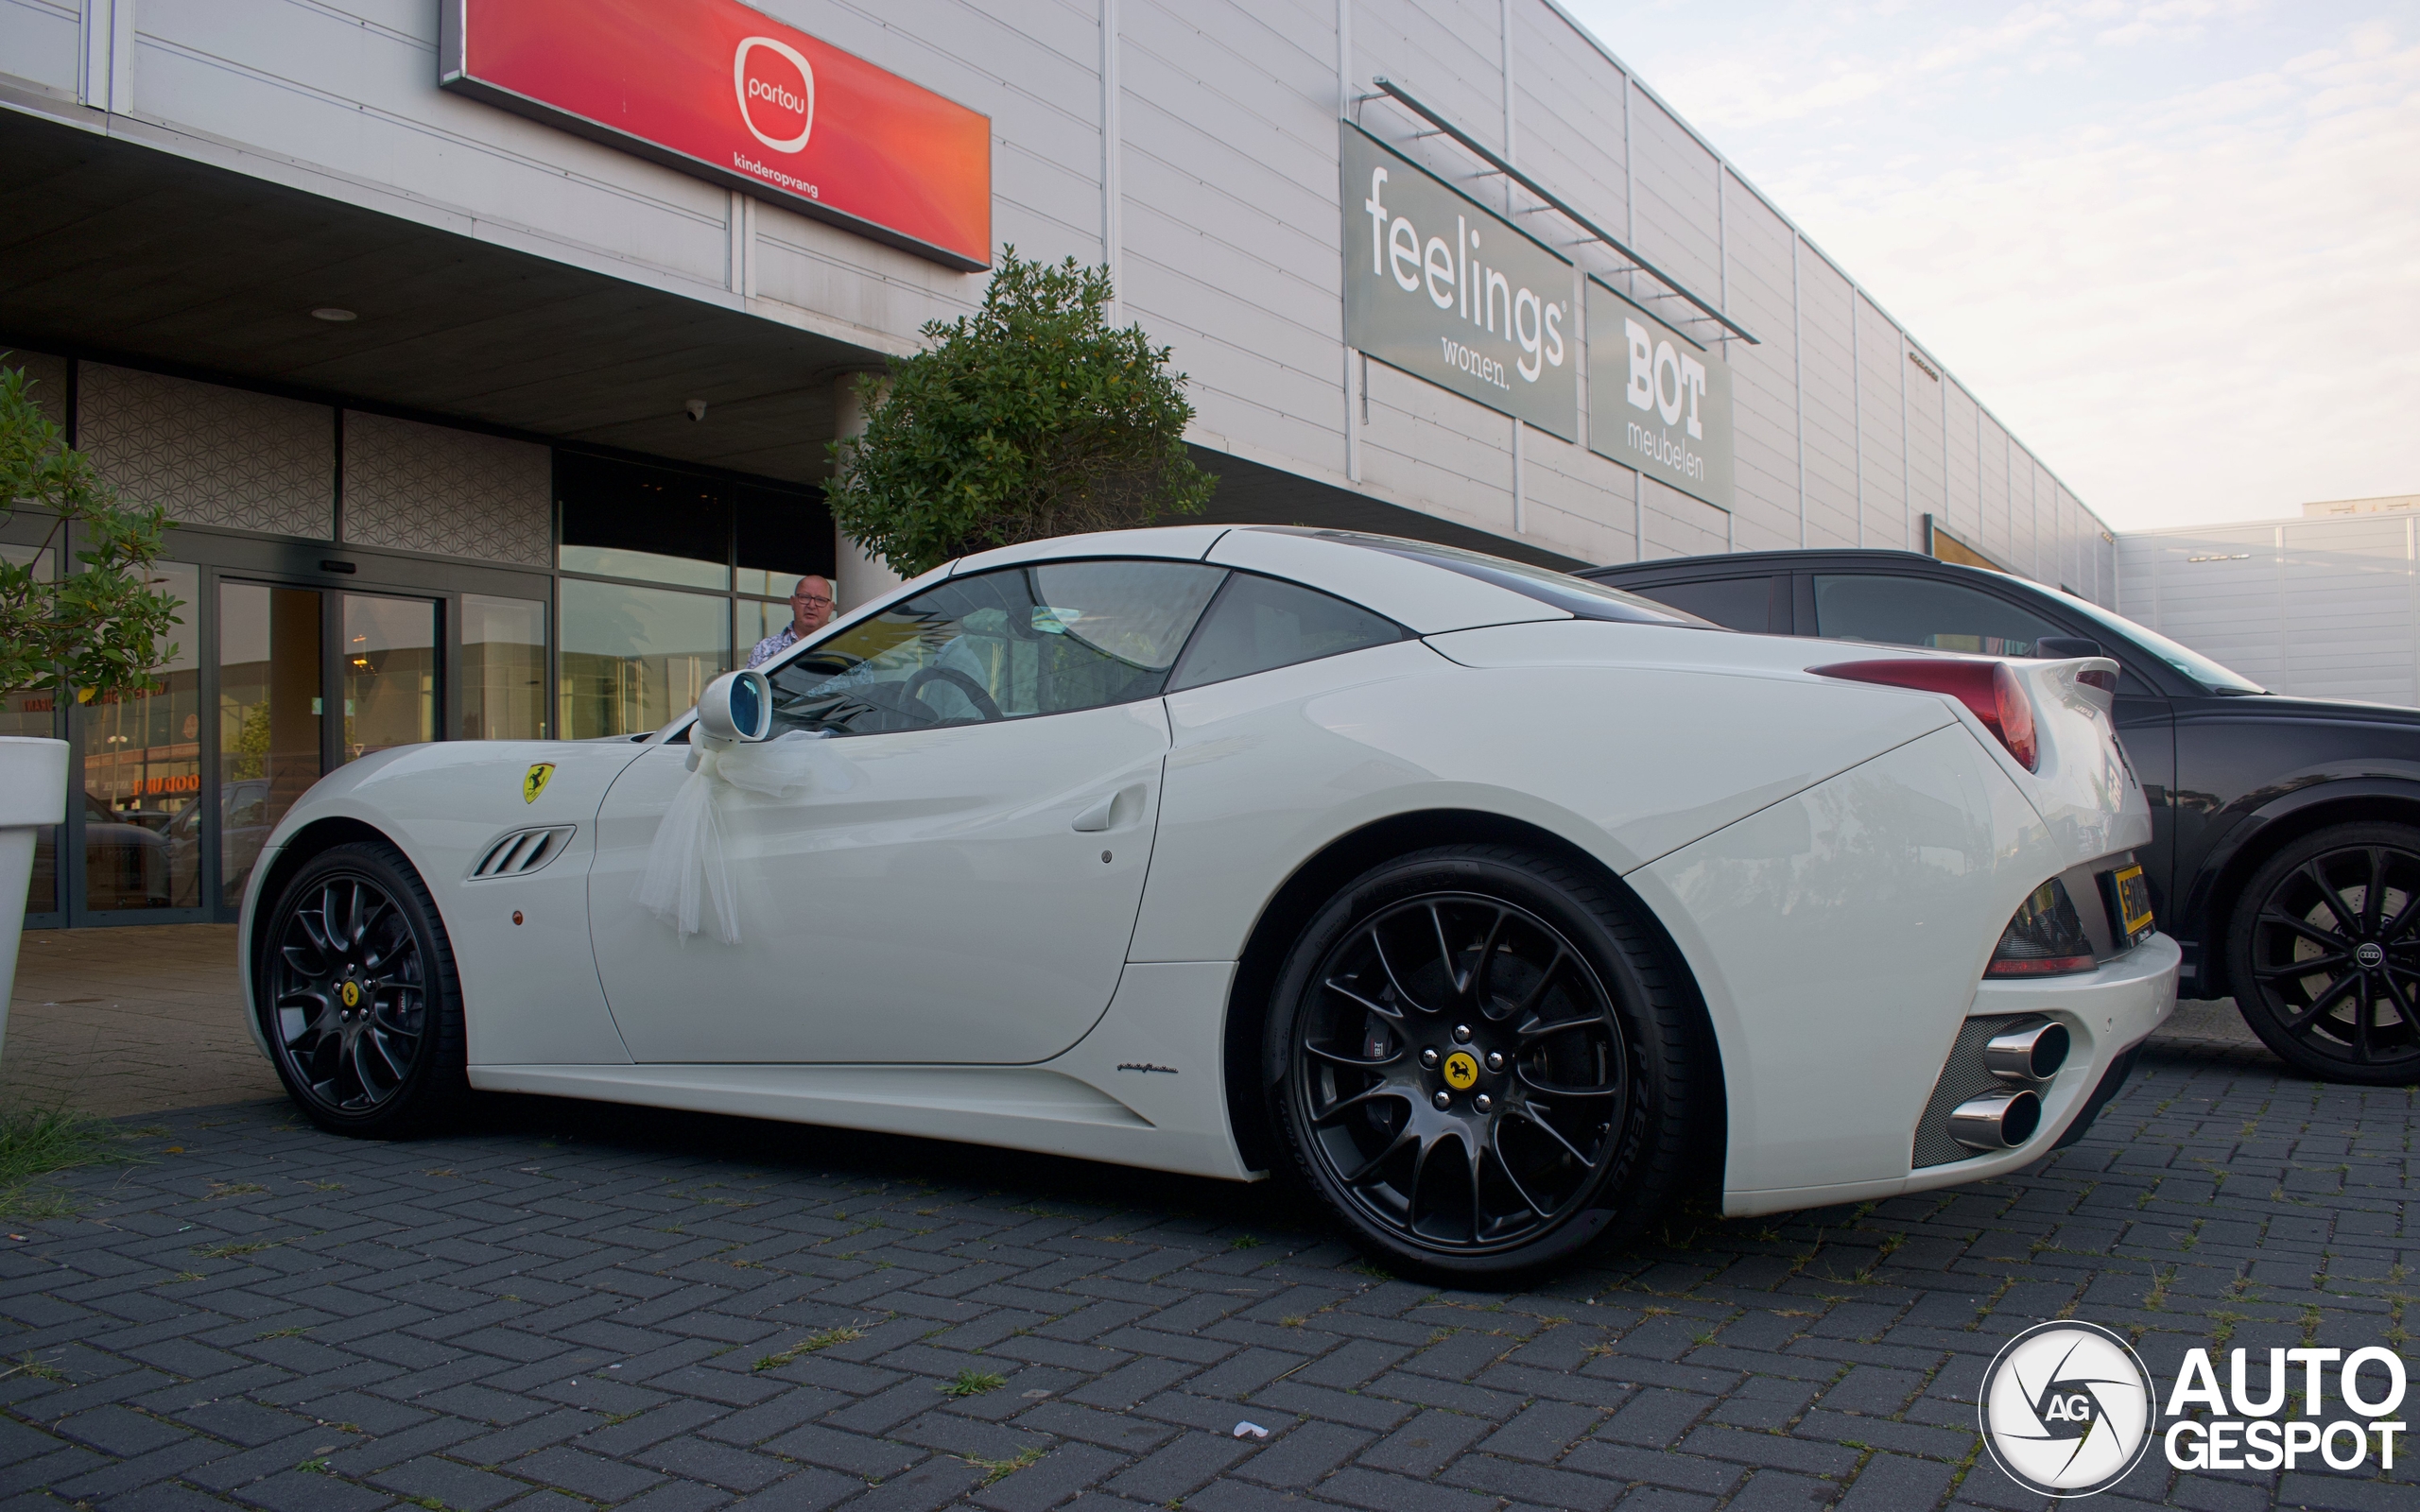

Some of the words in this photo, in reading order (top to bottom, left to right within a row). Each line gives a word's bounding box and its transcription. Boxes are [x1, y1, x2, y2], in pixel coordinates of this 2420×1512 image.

[748, 77, 805, 115] partou
[733, 151, 820, 198] kinderopvang
[1441, 336, 1511, 391] wonen.
[1625, 317, 1706, 441] BOT
[1627, 421, 1703, 482] meubelen
